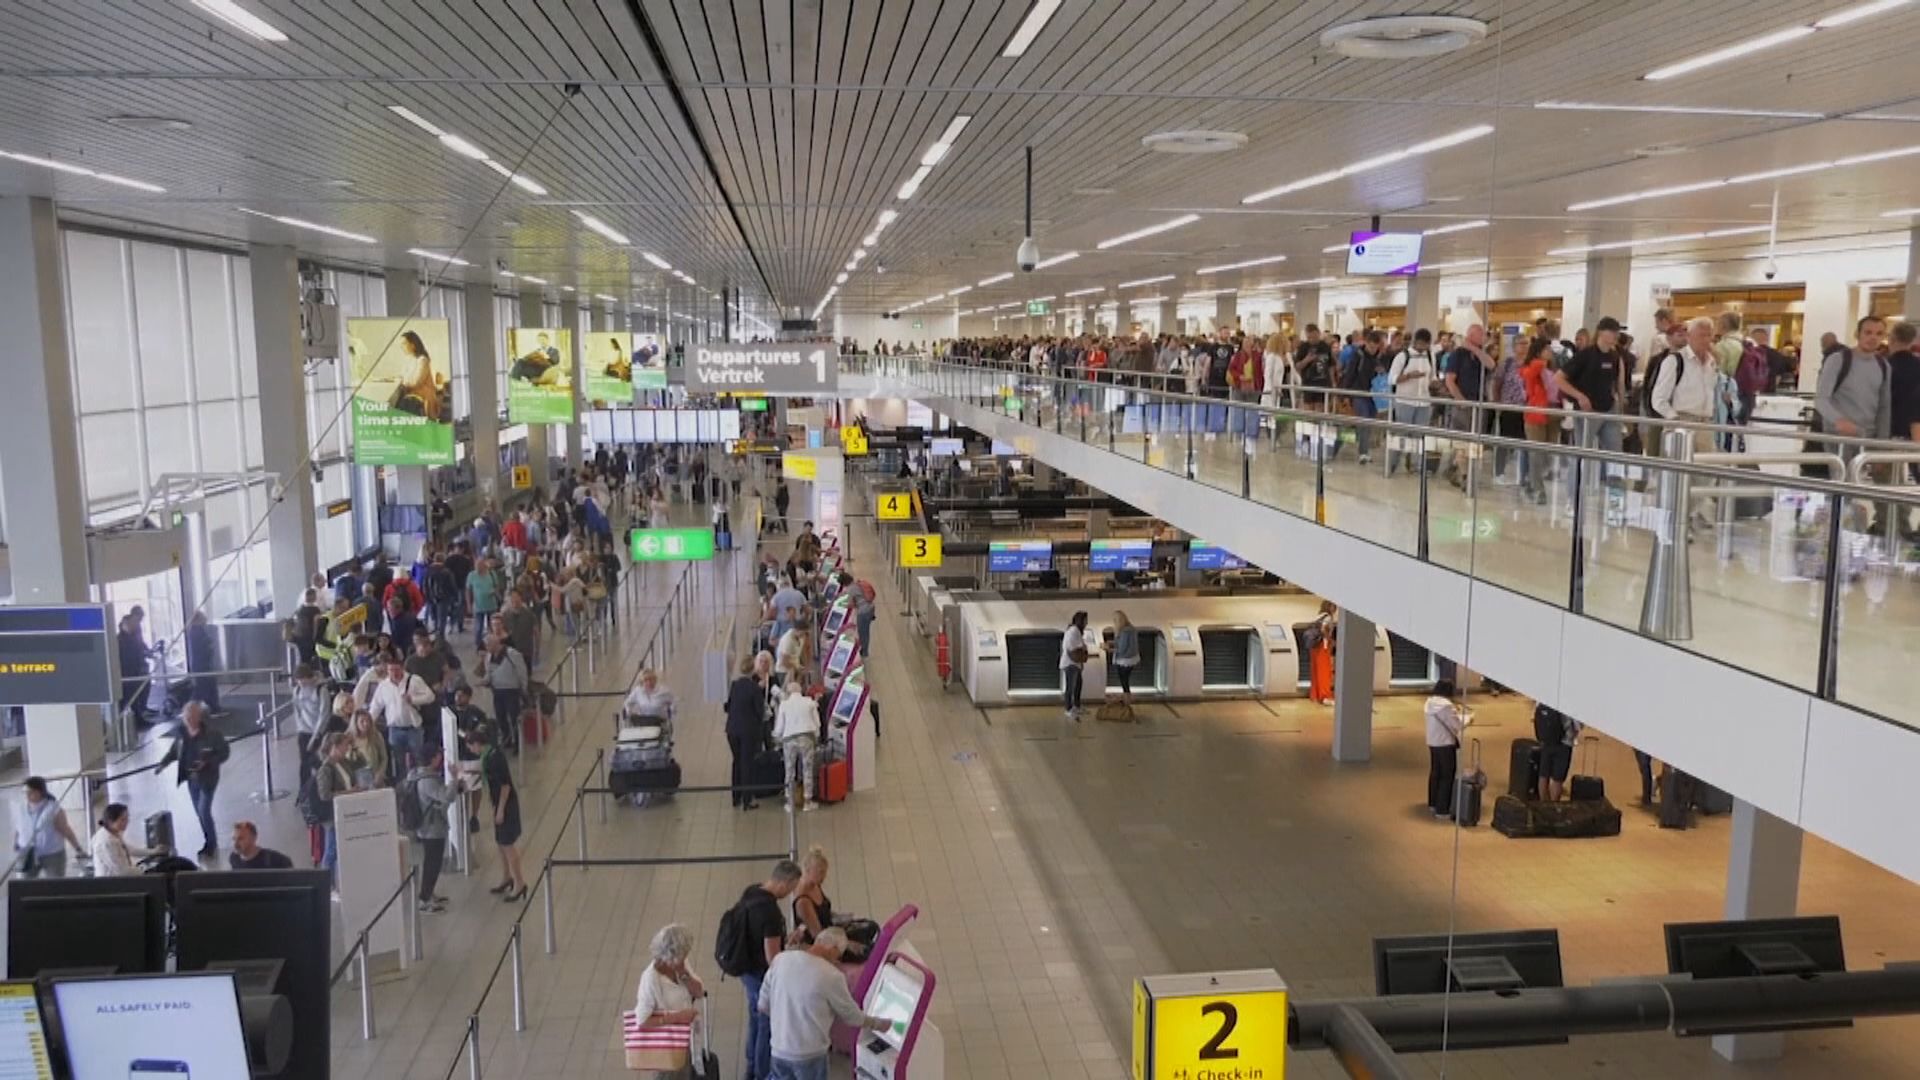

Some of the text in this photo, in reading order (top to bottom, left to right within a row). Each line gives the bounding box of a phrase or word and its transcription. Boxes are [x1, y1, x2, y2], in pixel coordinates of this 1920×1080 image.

[697, 348, 826, 383] Departures 1
[697, 366, 765, 384] Vertrek
[358, 400, 389, 412] Your
[358, 413, 428, 426] time saver
[887, 496, 898, 512] 4
[914, 538, 927, 558] 3
[11, 662, 56, 673] terrace
[96, 1005, 118, 1014] ALL
[119, 1002, 161, 1013] SAFELY
[1199, 1000, 1239, 1061] 2
[1197, 1066, 1263, 1080] Check-in
